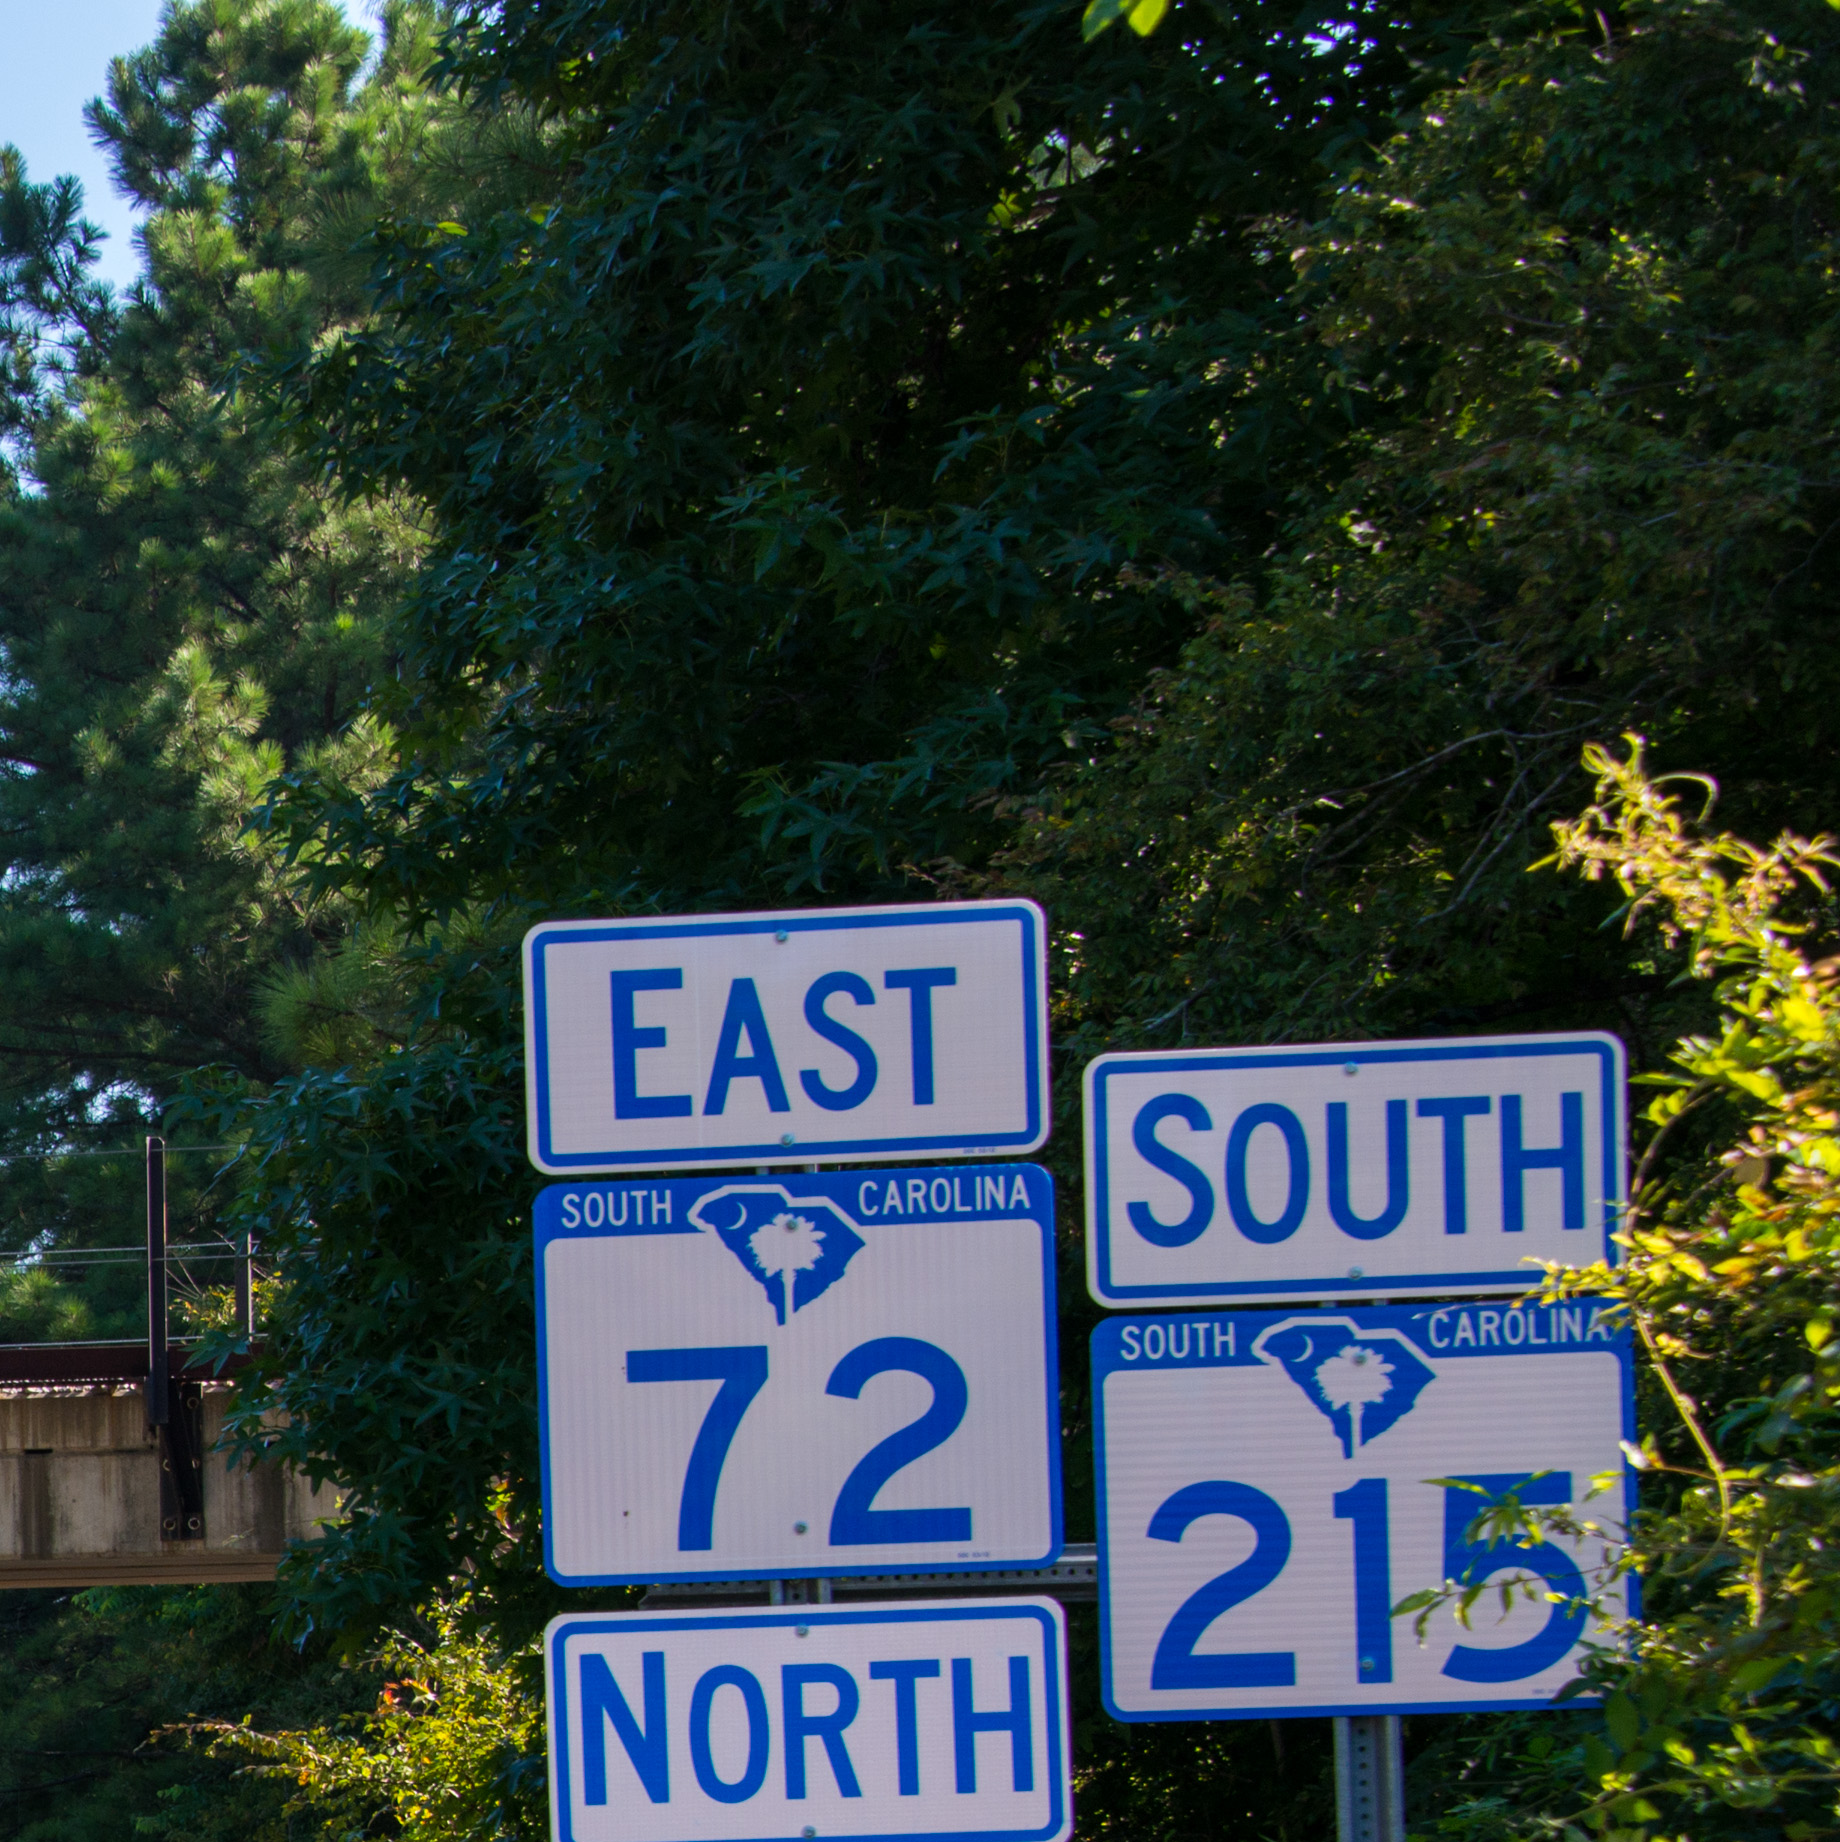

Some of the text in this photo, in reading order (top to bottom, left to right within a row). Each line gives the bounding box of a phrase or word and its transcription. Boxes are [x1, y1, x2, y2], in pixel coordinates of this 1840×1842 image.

[609, 966, 957, 1121] EAST
[560, 1174, 1031, 1229] SOUTH CAROLINA
[1127, 1091, 1584, 1248] SOUTH
[1120, 1307, 1613, 1361] SOUTH CAROLINA
[625, 1336, 973, 1552] 72
[1145, 1470, 1589, 1691] 215
[579, 1651, 1035, 1806] NORTH
